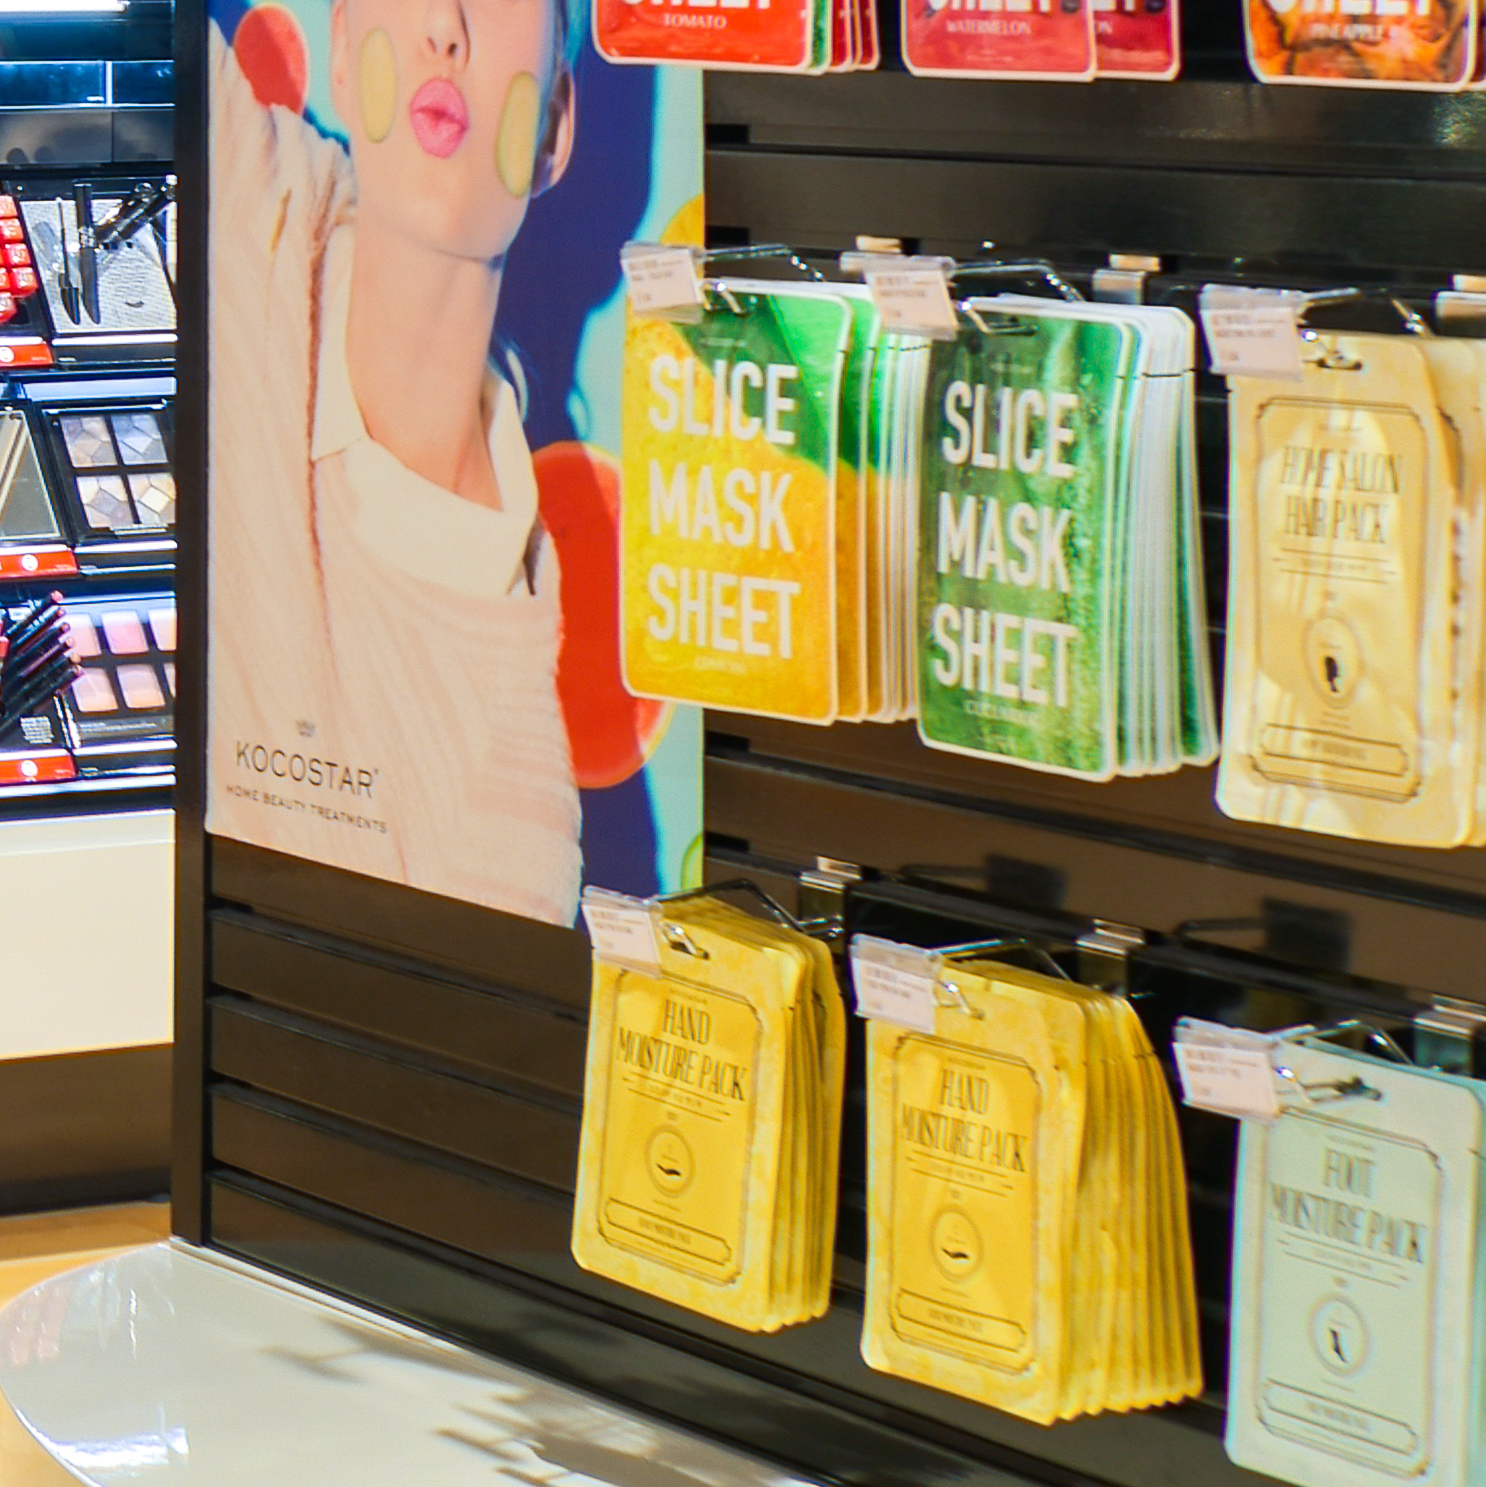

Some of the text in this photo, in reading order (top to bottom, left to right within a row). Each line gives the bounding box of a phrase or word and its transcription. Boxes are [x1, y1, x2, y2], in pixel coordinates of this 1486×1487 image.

[663, 12, 727, 31] TOMATO
[946, 19, 1031, 36] WATERMELON
[648, 354, 797, 445] SLICE
[942, 381, 1078, 479] SLICE
[1281, 446, 1403, 496] HOME SALON
[648, 460, 794, 554] MASK
[1331, 500, 1389, 546] PACK
[937, 493, 1069, 594] MASK
[648, 565, 799, 660] SHEET
[932, 606, 1076, 708] SHEET
[236, 741, 374, 799] KOCOSTAR
[227, 784, 388, 834] HOME BEAUTY TREATMENTS
[663, 998, 711, 1047] HAND
[617, 1027, 748, 1102] MOISTURE PACK
[941, 1068, 990, 1116] HAND
[902, 1104, 1027, 1173] MOISTURE PACK
